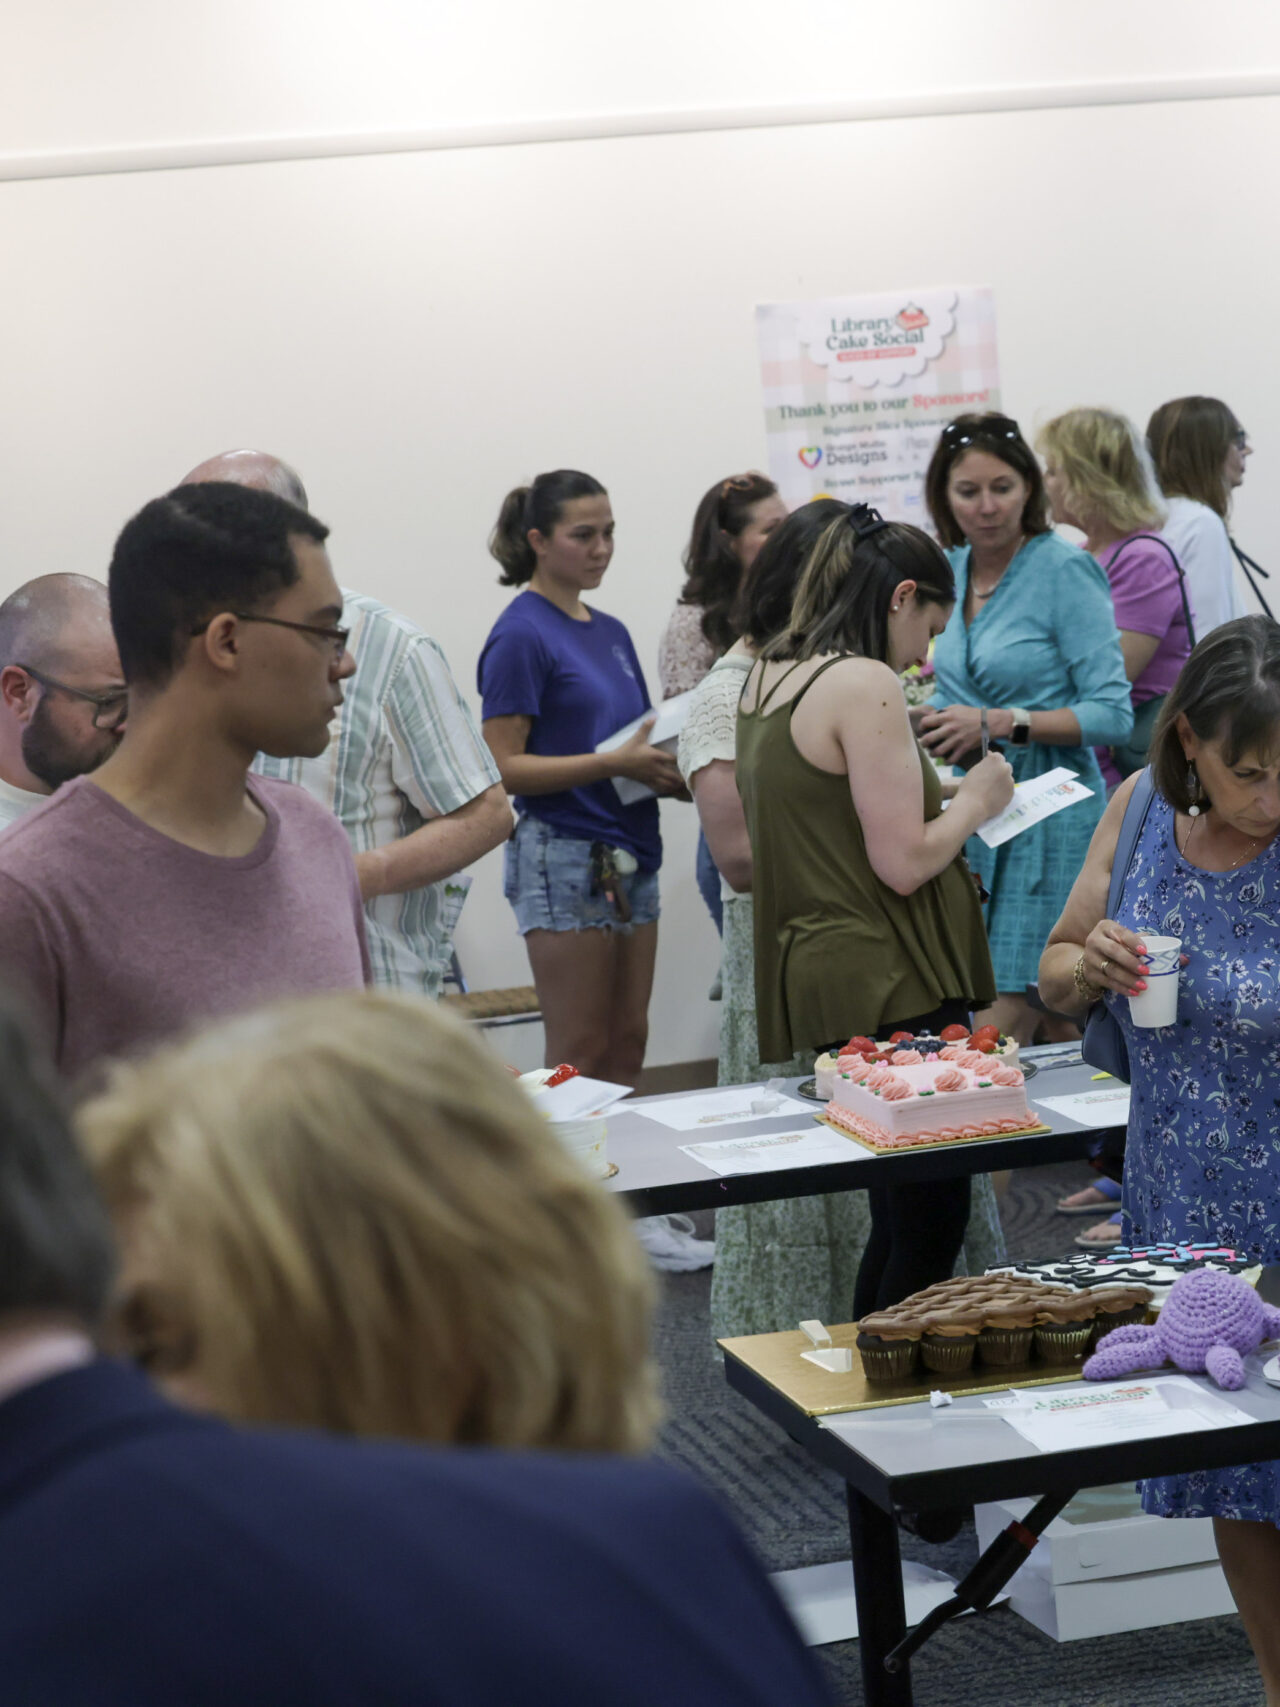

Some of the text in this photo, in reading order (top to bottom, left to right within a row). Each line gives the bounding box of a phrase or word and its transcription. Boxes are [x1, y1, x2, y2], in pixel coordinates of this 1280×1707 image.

[831, 317, 893, 333] Library
[825, 328, 925, 351] Cake Social
[778, 390, 990, 419] Thank you to our Sponsors!
[826, 450, 888, 466] Designs
